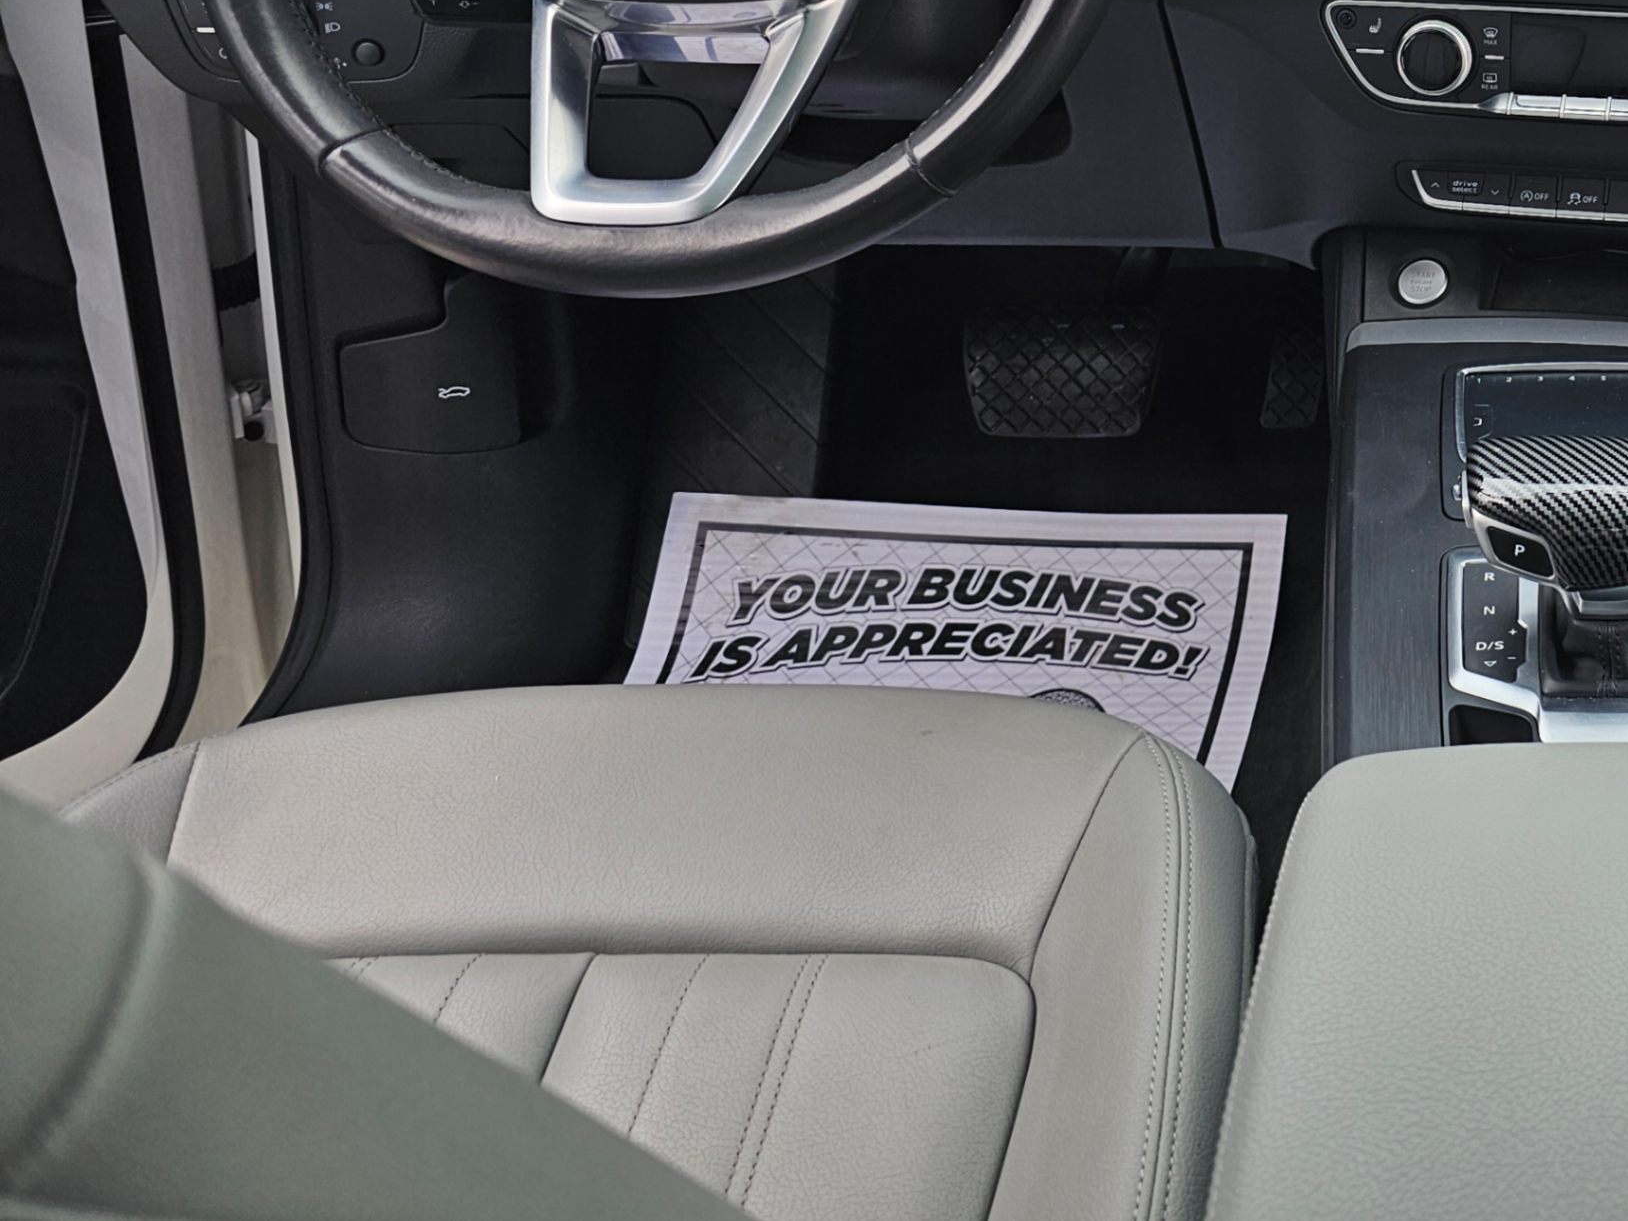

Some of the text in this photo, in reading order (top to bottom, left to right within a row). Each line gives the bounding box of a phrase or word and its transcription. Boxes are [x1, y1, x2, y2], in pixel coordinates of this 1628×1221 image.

[1534, 193, 1549, 201] OFF
[1582, 195, 1598, 204] OFF
[1514, 544, 1526, 557] P
[1484, 572, 1495, 581] R
[728, 566, 1205, 631] YOUR BUSINESS
[1483, 606, 1496, 615] N
[689, 620, 1210, 679] IS APPRECIATED!
[1475, 641, 1505, 651] D/S
